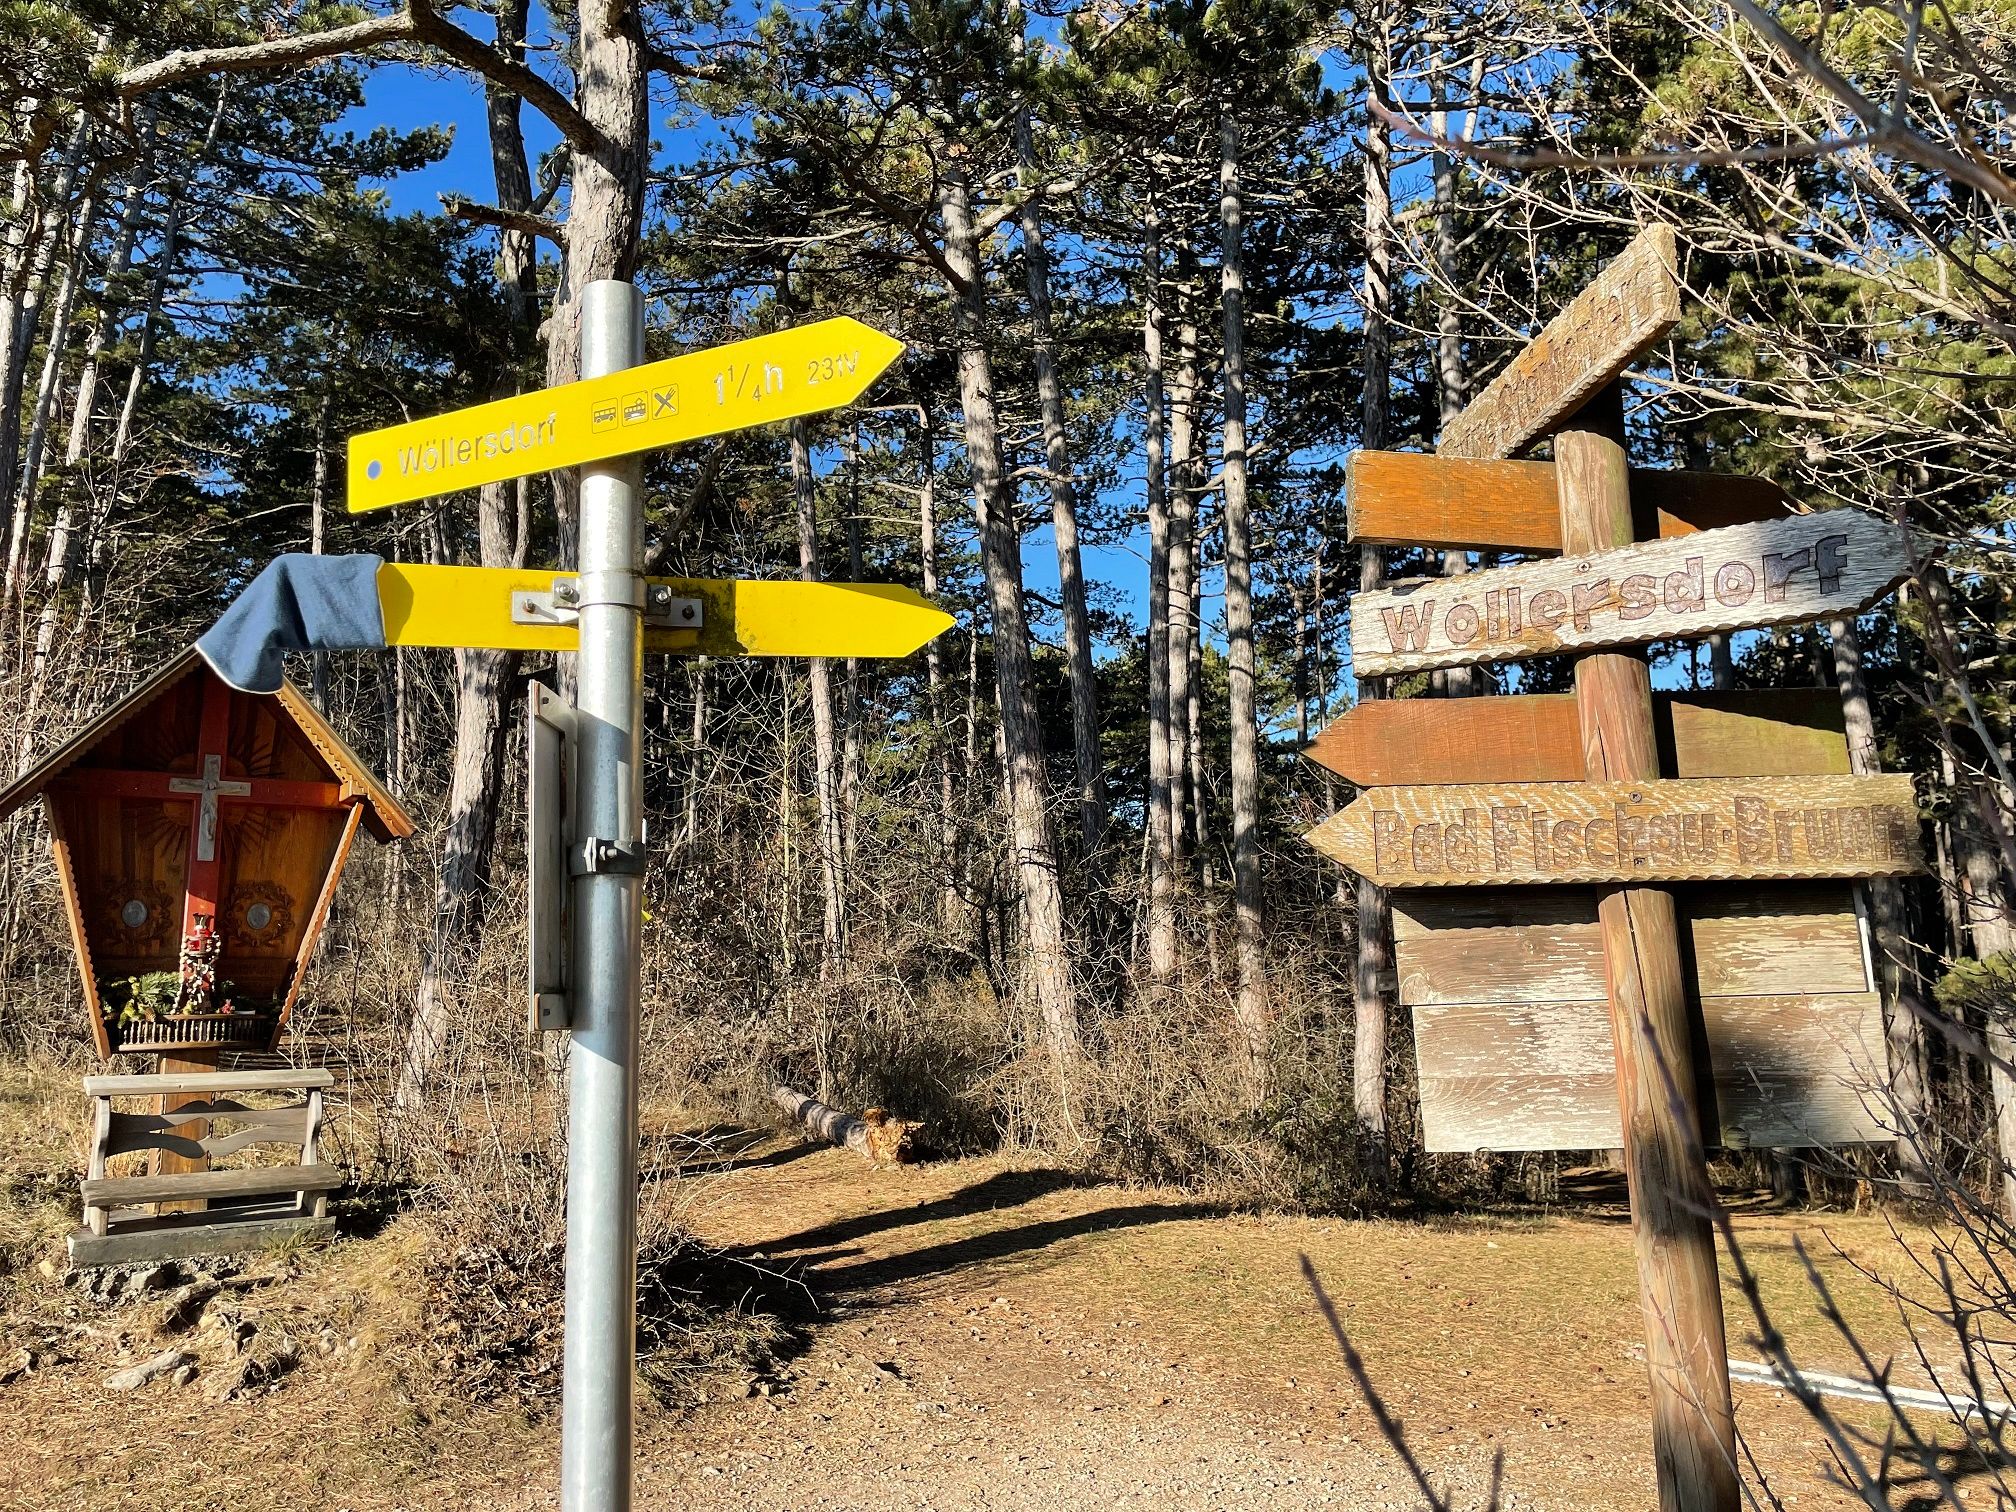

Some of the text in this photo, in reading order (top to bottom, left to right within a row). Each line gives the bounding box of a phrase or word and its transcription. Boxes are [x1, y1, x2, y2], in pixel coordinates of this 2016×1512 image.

[399, 412, 557, 476] Wöllersdorf
[807, 350, 859, 385] 231V
[1381, 534, 1848, 654] Wöllersdorf
[1373, 796, 1909, 875] Bad Fischau-Brunn
